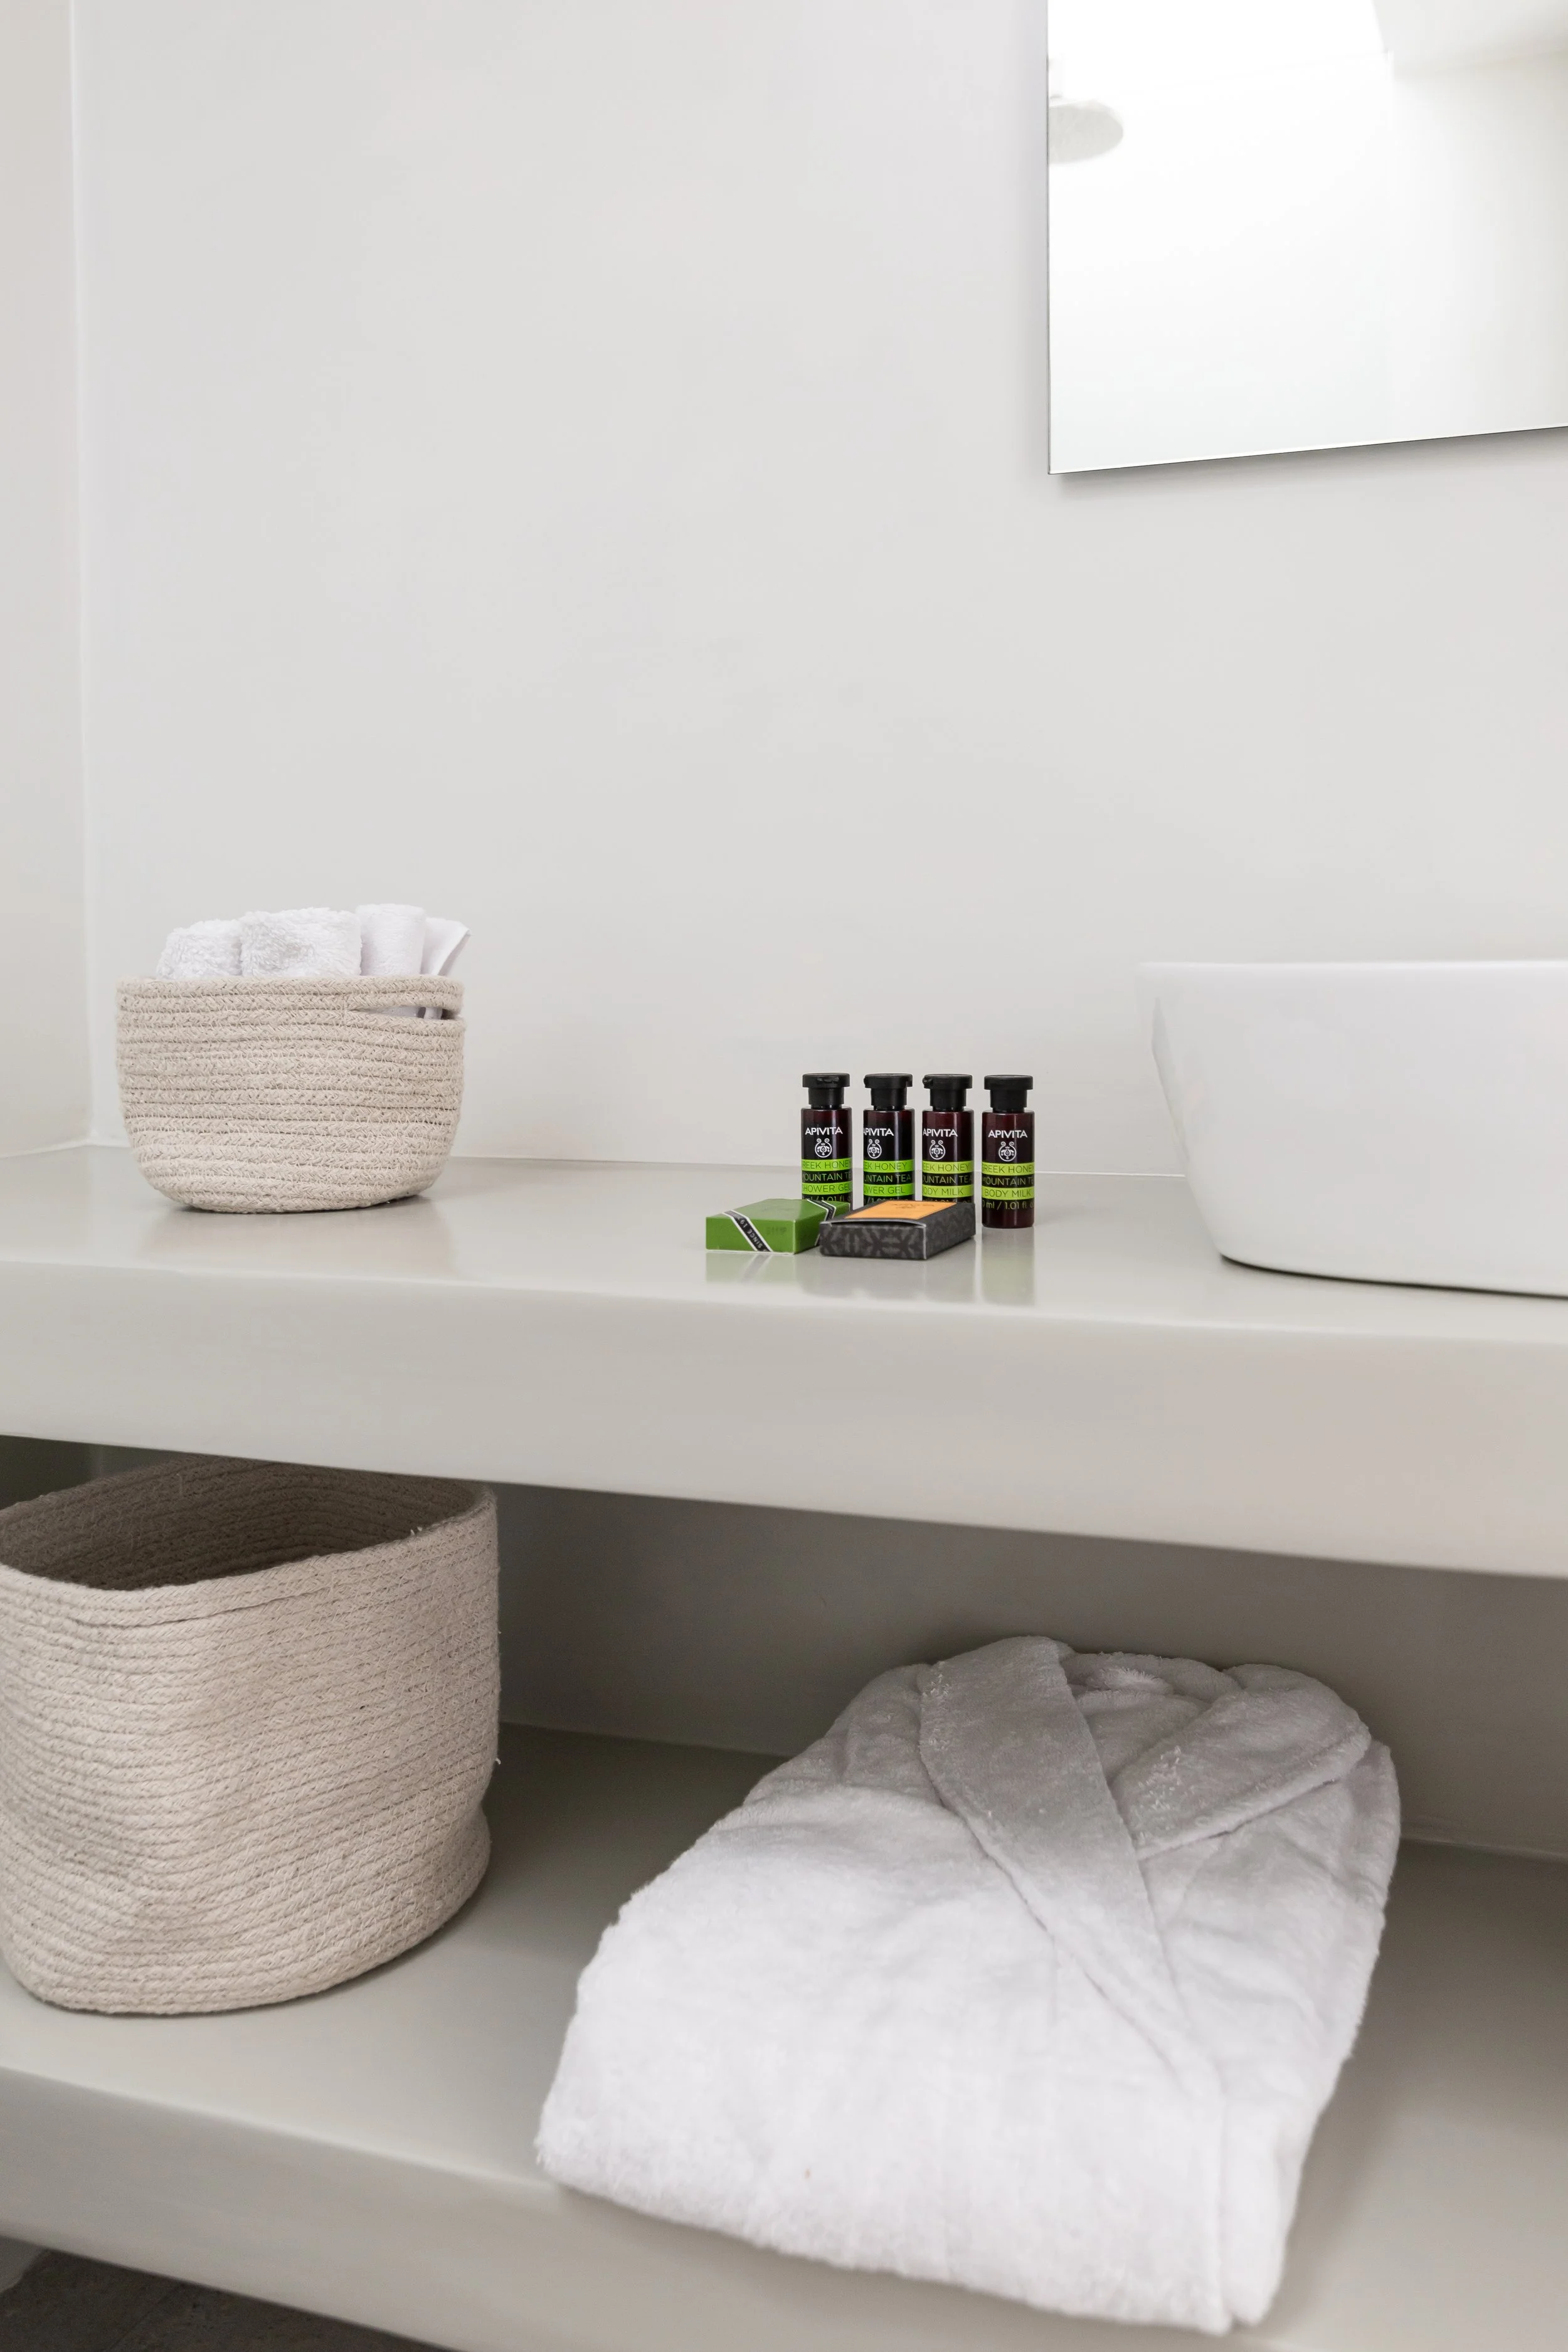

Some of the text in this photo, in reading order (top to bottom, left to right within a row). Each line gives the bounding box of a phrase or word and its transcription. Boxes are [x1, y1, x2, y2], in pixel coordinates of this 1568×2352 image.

[805, 1126, 843, 1135] APIVITA
[923, 1128, 958, 1137] APIVITA
[988, 1130, 1027, 1138] APIVITA
[802, 1161, 822, 1169] REEK
[875, 1162, 907, 1170] HONEY
[938, 1163, 970, 1172] HONEY
[802, 1172, 842, 1181] OUNTAIN
[896, 1174, 911, 1182] TEA
[802, 1184, 851, 1193] HOWER GEL
[887, 1186, 906, 1194] GEL
[923, 1187, 938, 1195] ODY
[984, 1189, 1031, 1197] BODY MILK
[986, 1200, 995, 1209] ml
[1005, 1202, 1019, 1210] 1.01
[748, 1229, 763, 1248] SINCE
